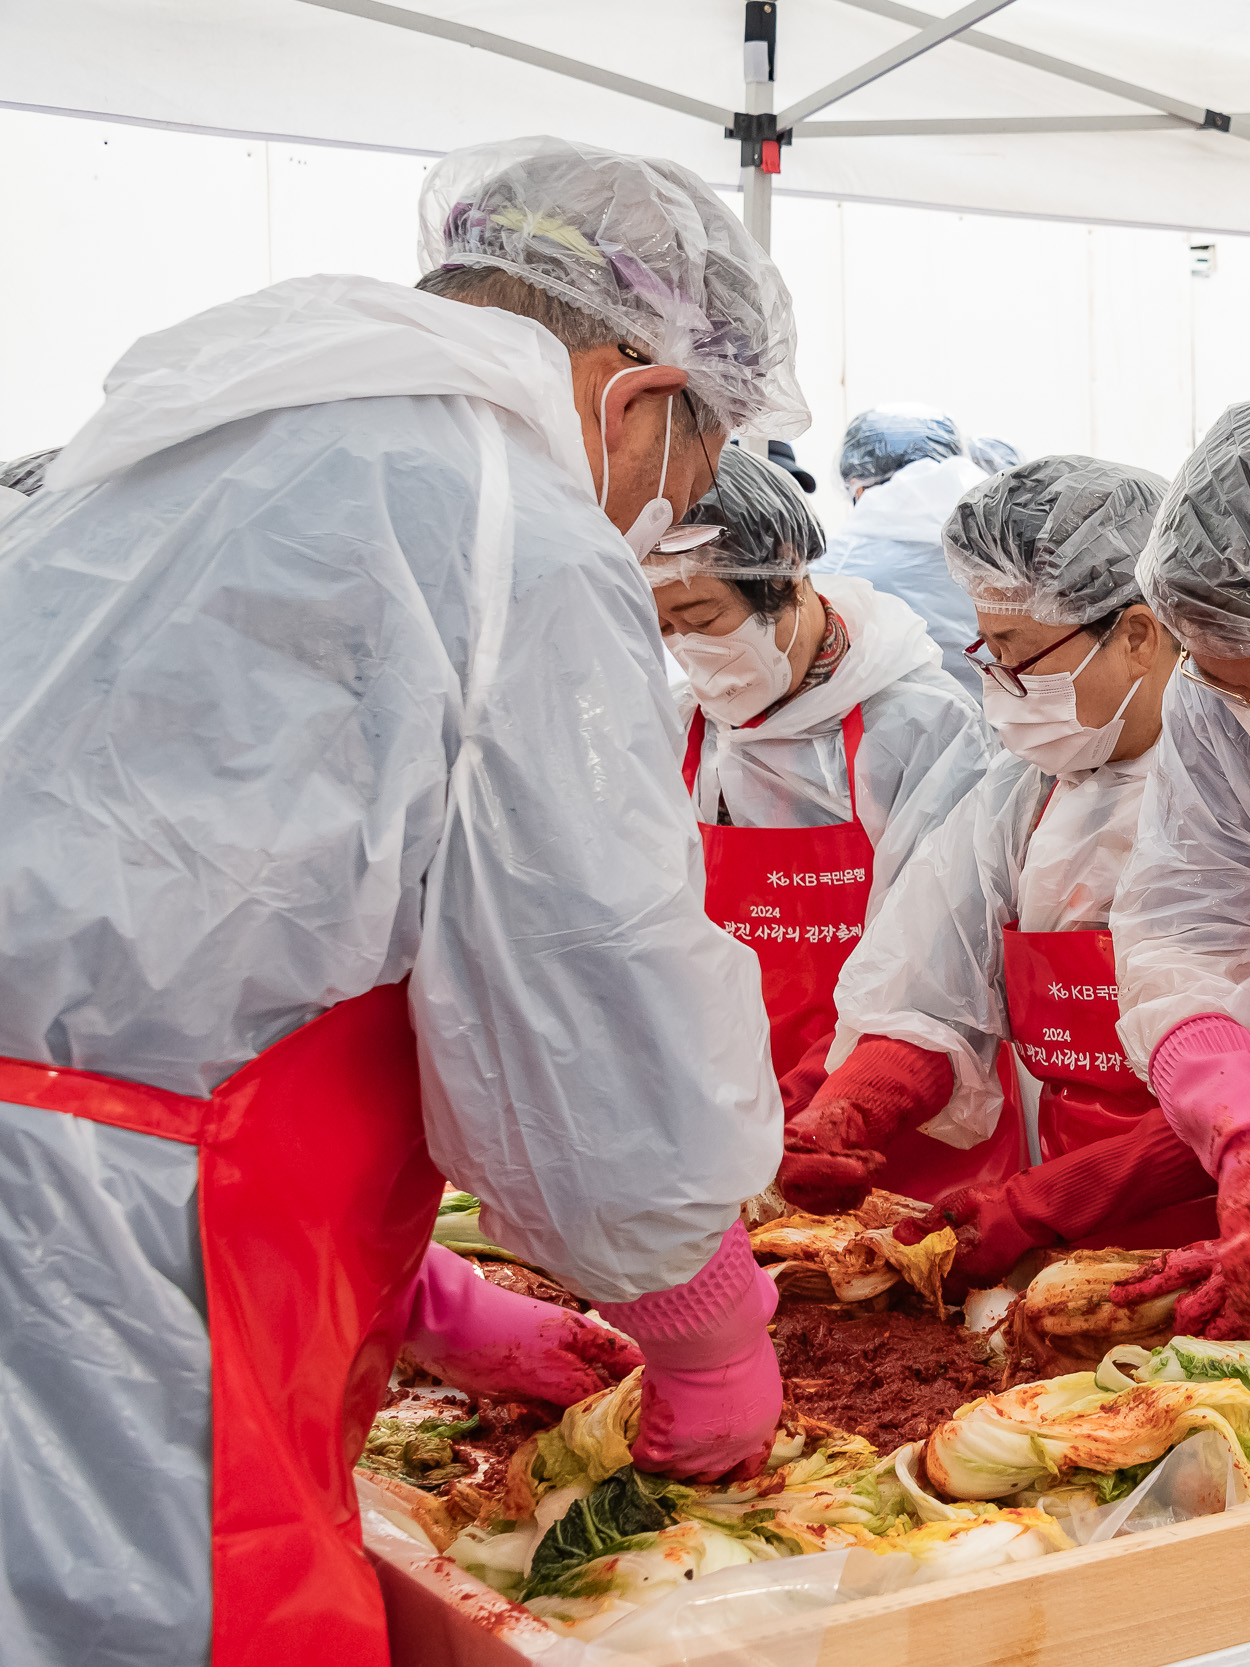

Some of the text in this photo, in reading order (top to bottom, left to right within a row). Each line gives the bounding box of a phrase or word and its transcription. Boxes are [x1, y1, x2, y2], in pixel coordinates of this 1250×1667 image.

[750, 905, 781, 919] 2024
[723, 920, 752, 940] 광진
[754, 923, 800, 943] 사랑의
[1042, 1027, 1072, 1043] 2024
[1024, 1042, 1049, 1066] 광진
[1050, 1048, 1091, 1071] 사랑의
